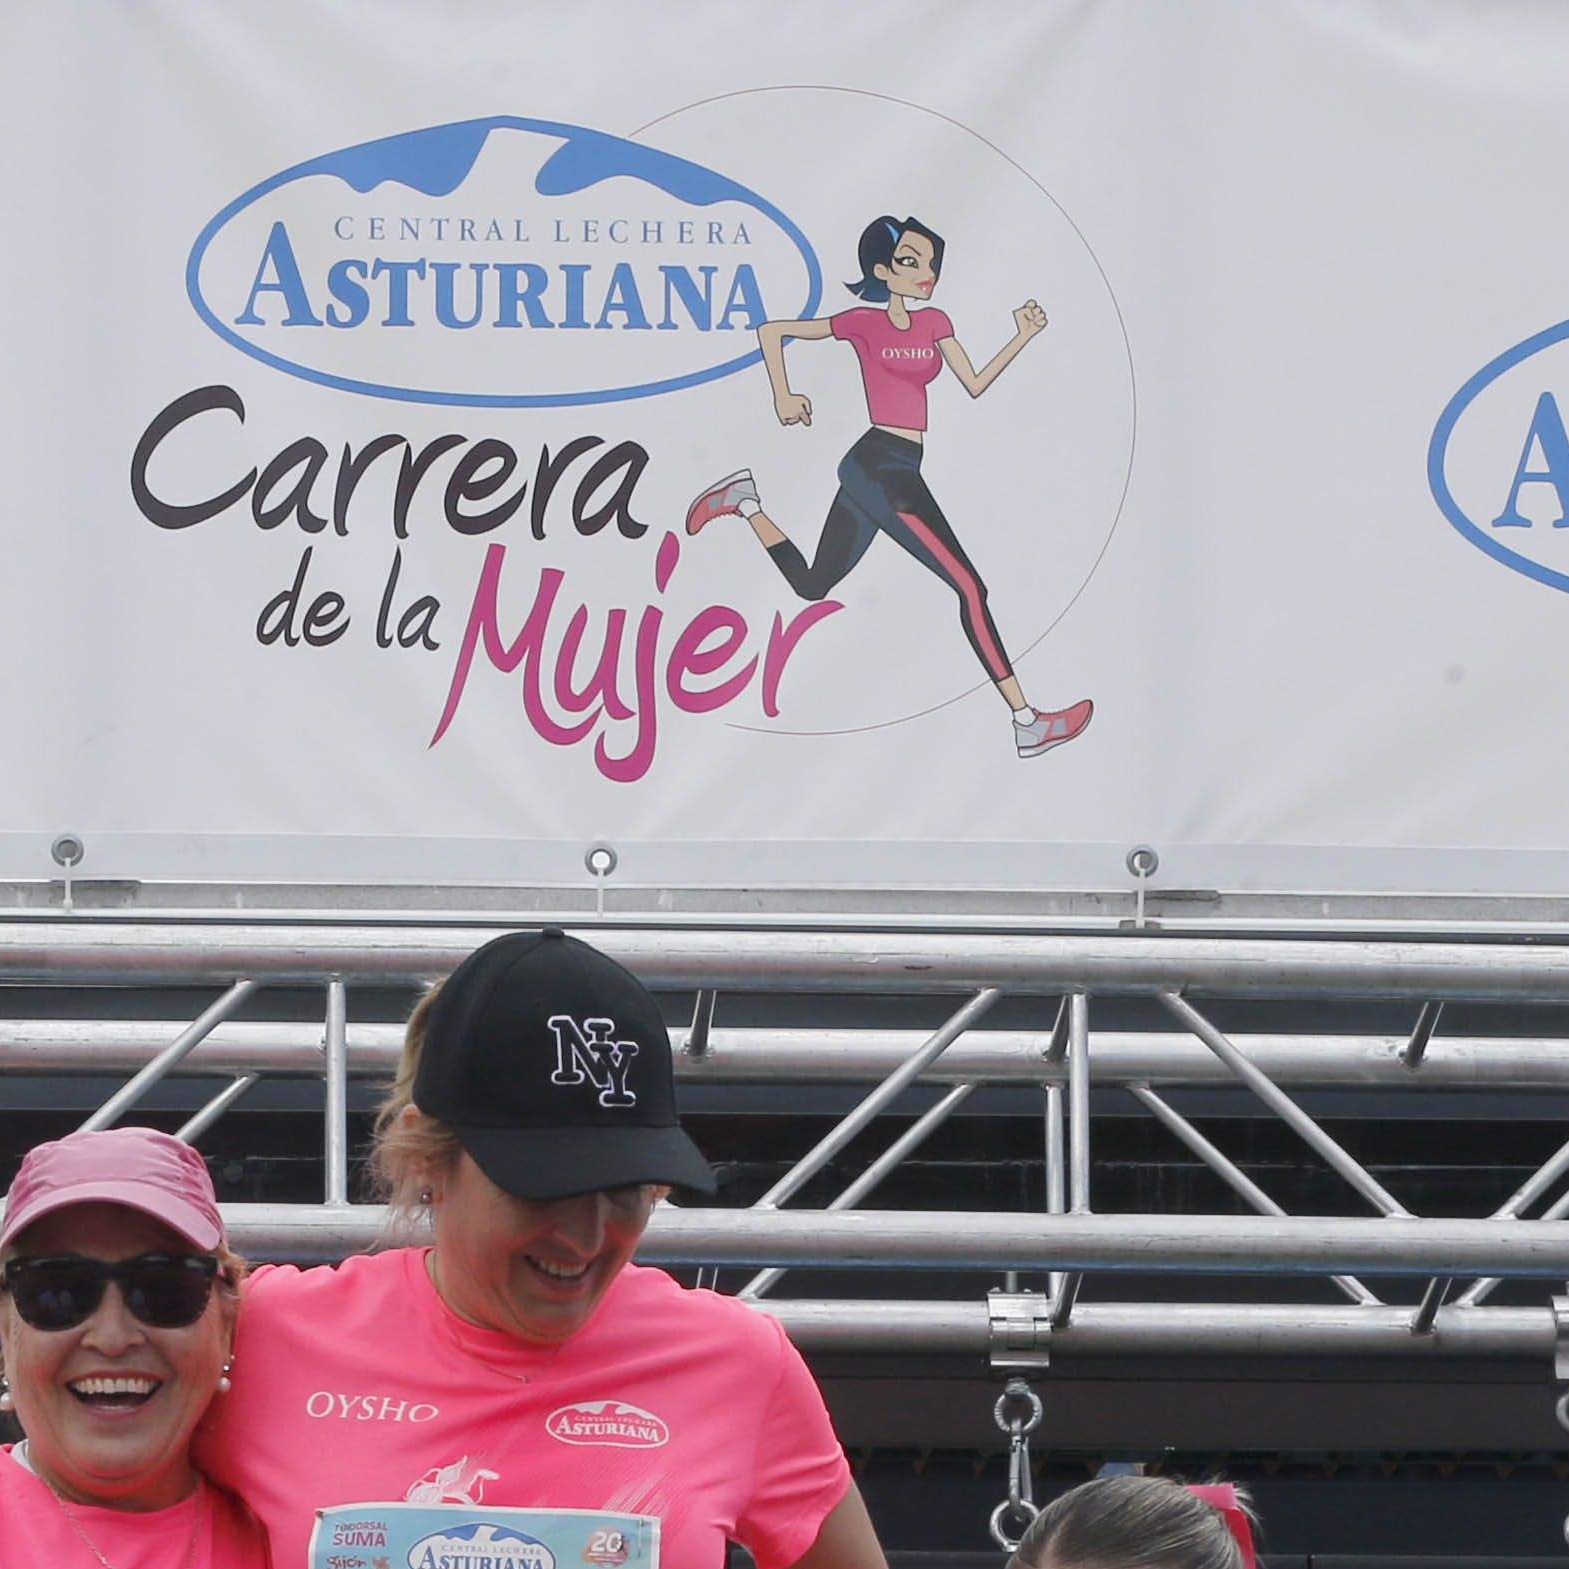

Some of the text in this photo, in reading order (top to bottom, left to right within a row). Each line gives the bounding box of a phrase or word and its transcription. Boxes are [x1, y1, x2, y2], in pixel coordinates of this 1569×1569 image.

[334, 215, 753, 246] CENTRAL LECHERA
[234, 220, 769, 333] ASTURIANA
[881, 346, 935, 360] OYSHO
[129, 384, 652, 540] Carrera
[256, 530, 846, 783] de la Mujer
[546, 1014, 640, 1107] NY
[306, 1391, 439, 1423] OYSHO
[555, 1415, 659, 1442] ASTURIANA
[333, 1532, 386, 1547] SUMA
